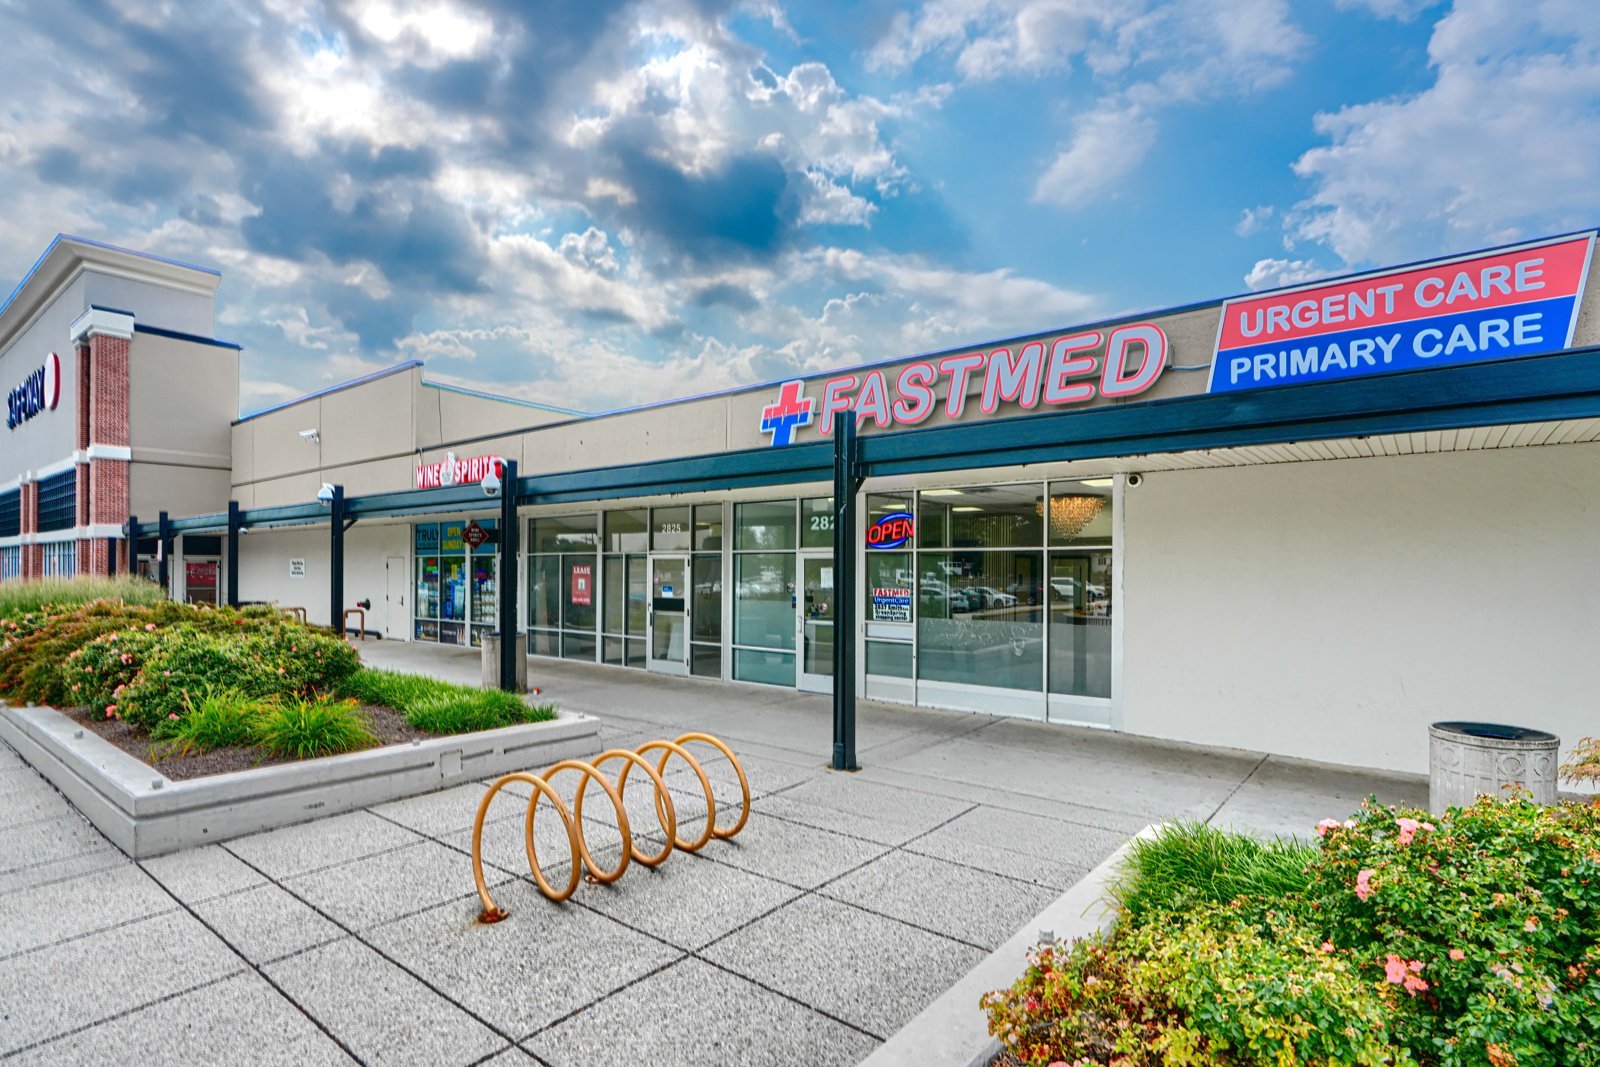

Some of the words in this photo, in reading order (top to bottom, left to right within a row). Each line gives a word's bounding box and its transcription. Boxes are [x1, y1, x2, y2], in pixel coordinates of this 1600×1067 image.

[1239, 283, 1404, 338] URGENT
[1413, 258, 1546, 308] CARE
[1229, 332, 1402, 384] PRIMARY
[1412, 312, 1544, 359] CARE
[818, 323, 1170, 436] FASTMED
[7, 364, 46, 430] SAFEWAY
[416, 464, 440, 489] WINE
[454, 456, 492, 484] SPIRIT
[447, 526, 461, 538] OPEN
[662, 524, 681, 533] 2825
[810, 515, 835, 531] 282
[868, 519, 914, 544] OPEN
[573, 566, 591, 575] LEASE
[873, 588, 909, 597] FASTMED
